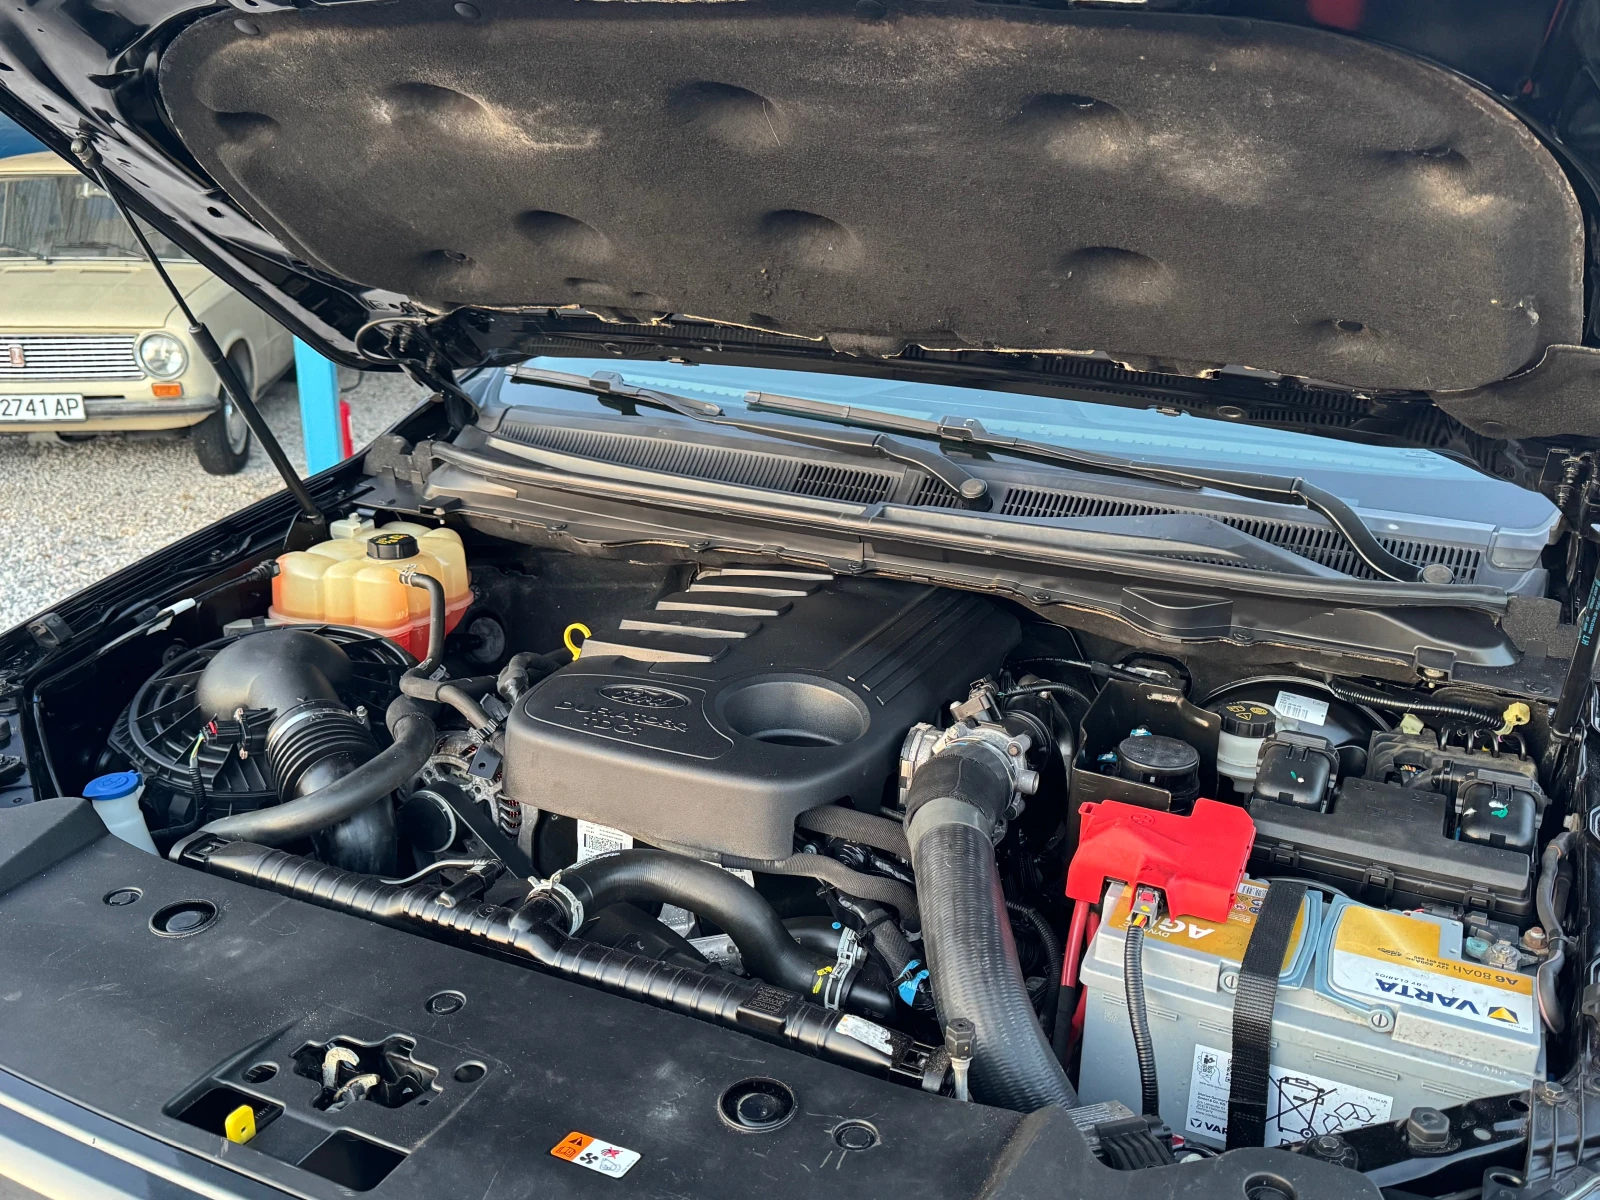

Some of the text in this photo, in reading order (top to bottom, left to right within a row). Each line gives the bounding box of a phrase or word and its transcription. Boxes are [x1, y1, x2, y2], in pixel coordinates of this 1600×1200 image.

[0, 398, 79, 416] 2741 AP
[1581, 634, 1590, 646] LH
[609, 687, 678, 708] Ford
[554, 701, 690, 733] DURATORQ
[1123, 921, 1171, 938] DYNAC
[1453, 964, 1519, 986] A6 80Ah
[1375, 978, 1480, 1016] VARTA
[1205, 1121, 1228, 1136] VAR
